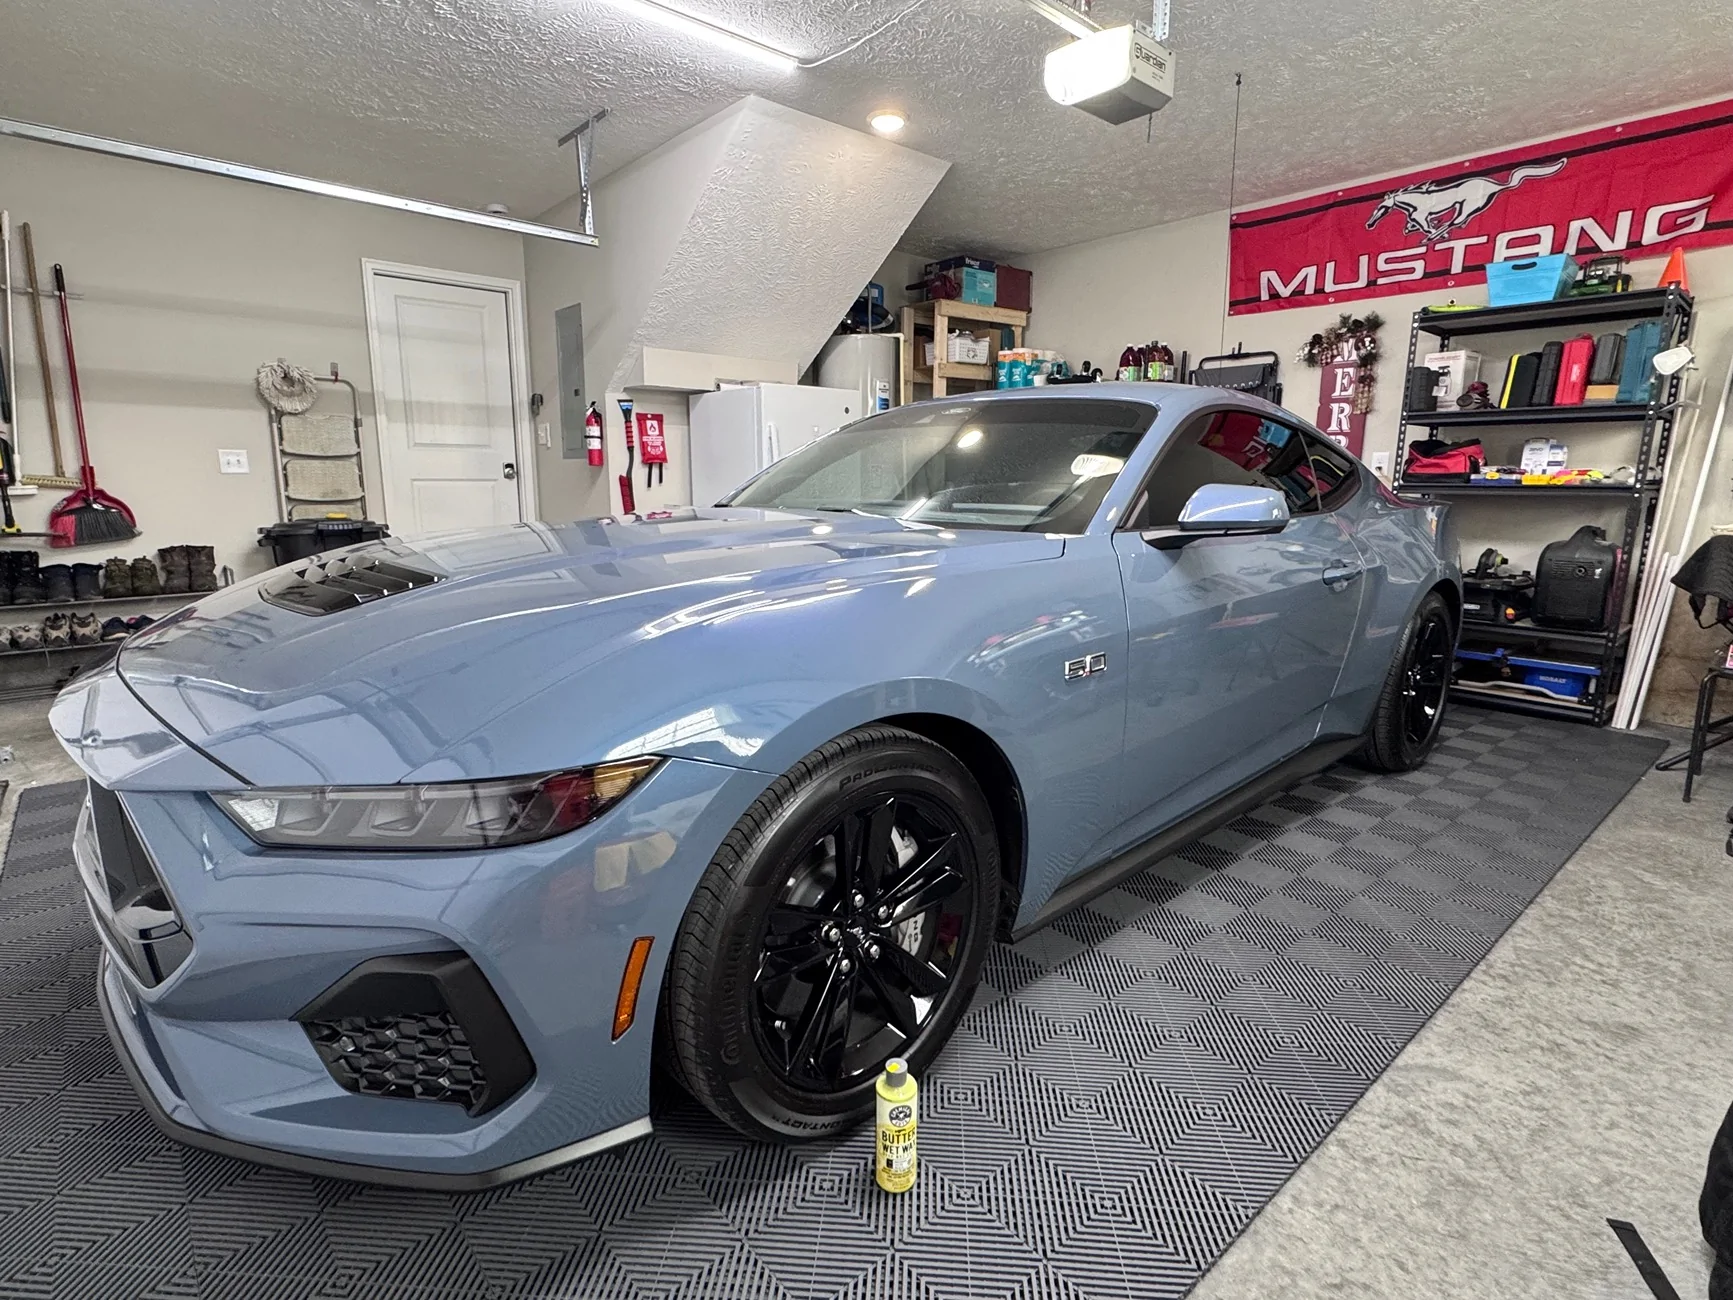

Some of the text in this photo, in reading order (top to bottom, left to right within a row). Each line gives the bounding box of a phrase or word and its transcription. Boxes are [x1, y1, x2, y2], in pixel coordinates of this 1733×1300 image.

[1134, 42, 1166, 72] Guardian
[1260, 195, 1714, 301] MUSTANG
[882, 1142, 900, 1155] WET
